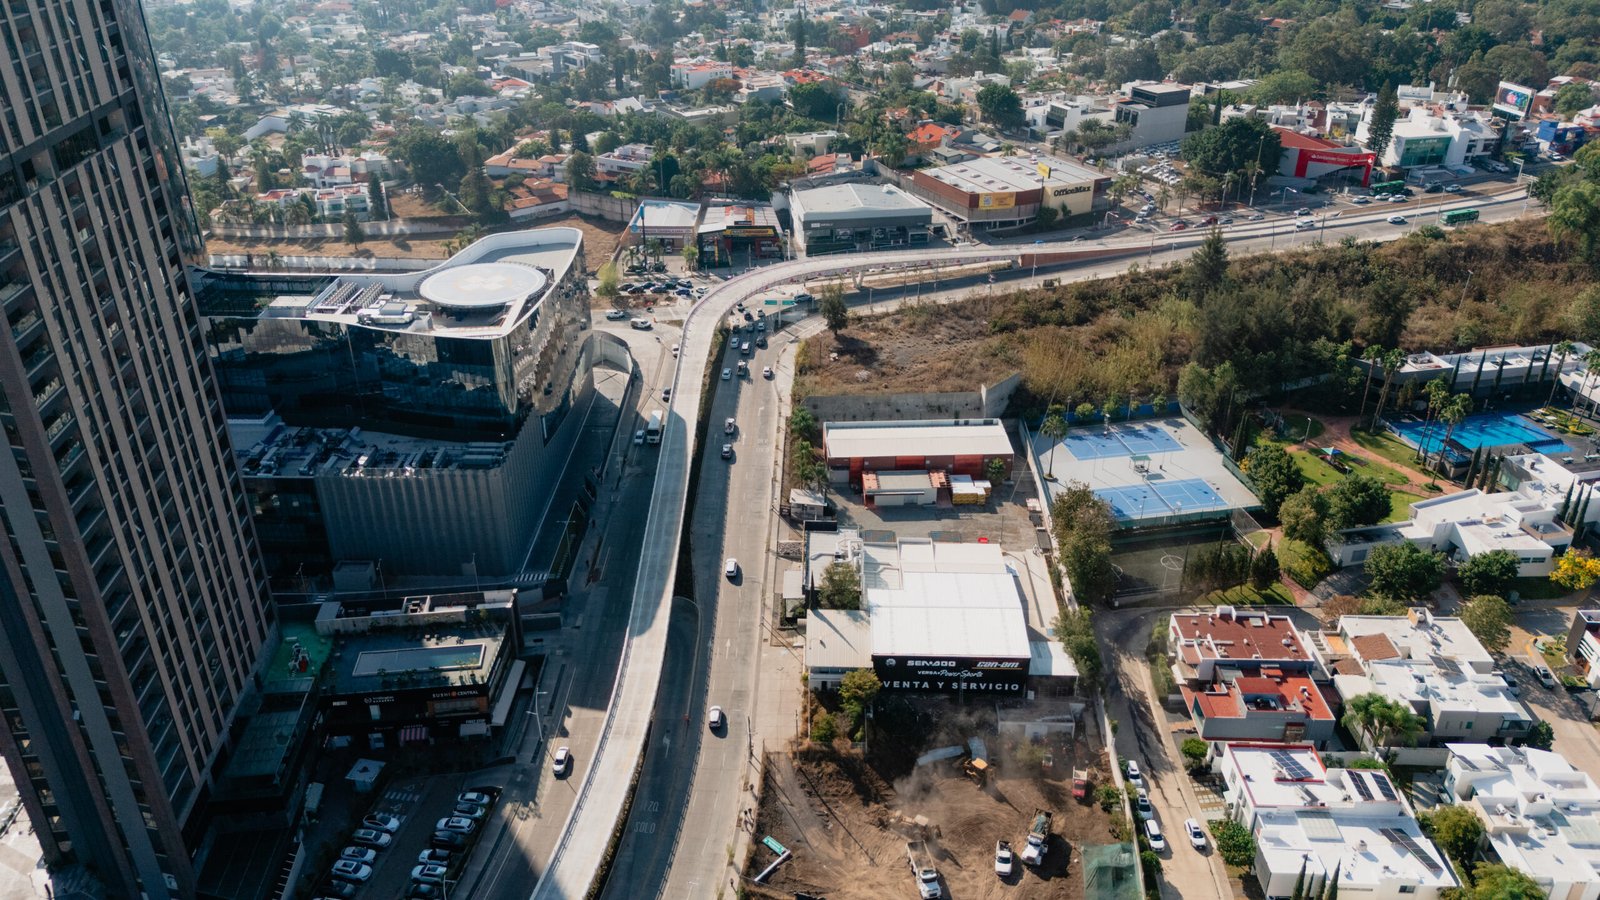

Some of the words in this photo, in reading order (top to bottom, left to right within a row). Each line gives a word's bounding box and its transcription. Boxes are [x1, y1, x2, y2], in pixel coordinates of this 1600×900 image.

[1054, 186, 1091, 197] OfficeMax
[883, 681, 930, 689] VENTA
[937, 681, 945, 689] Y
[952, 682, 1019, 691] SERVICIO
